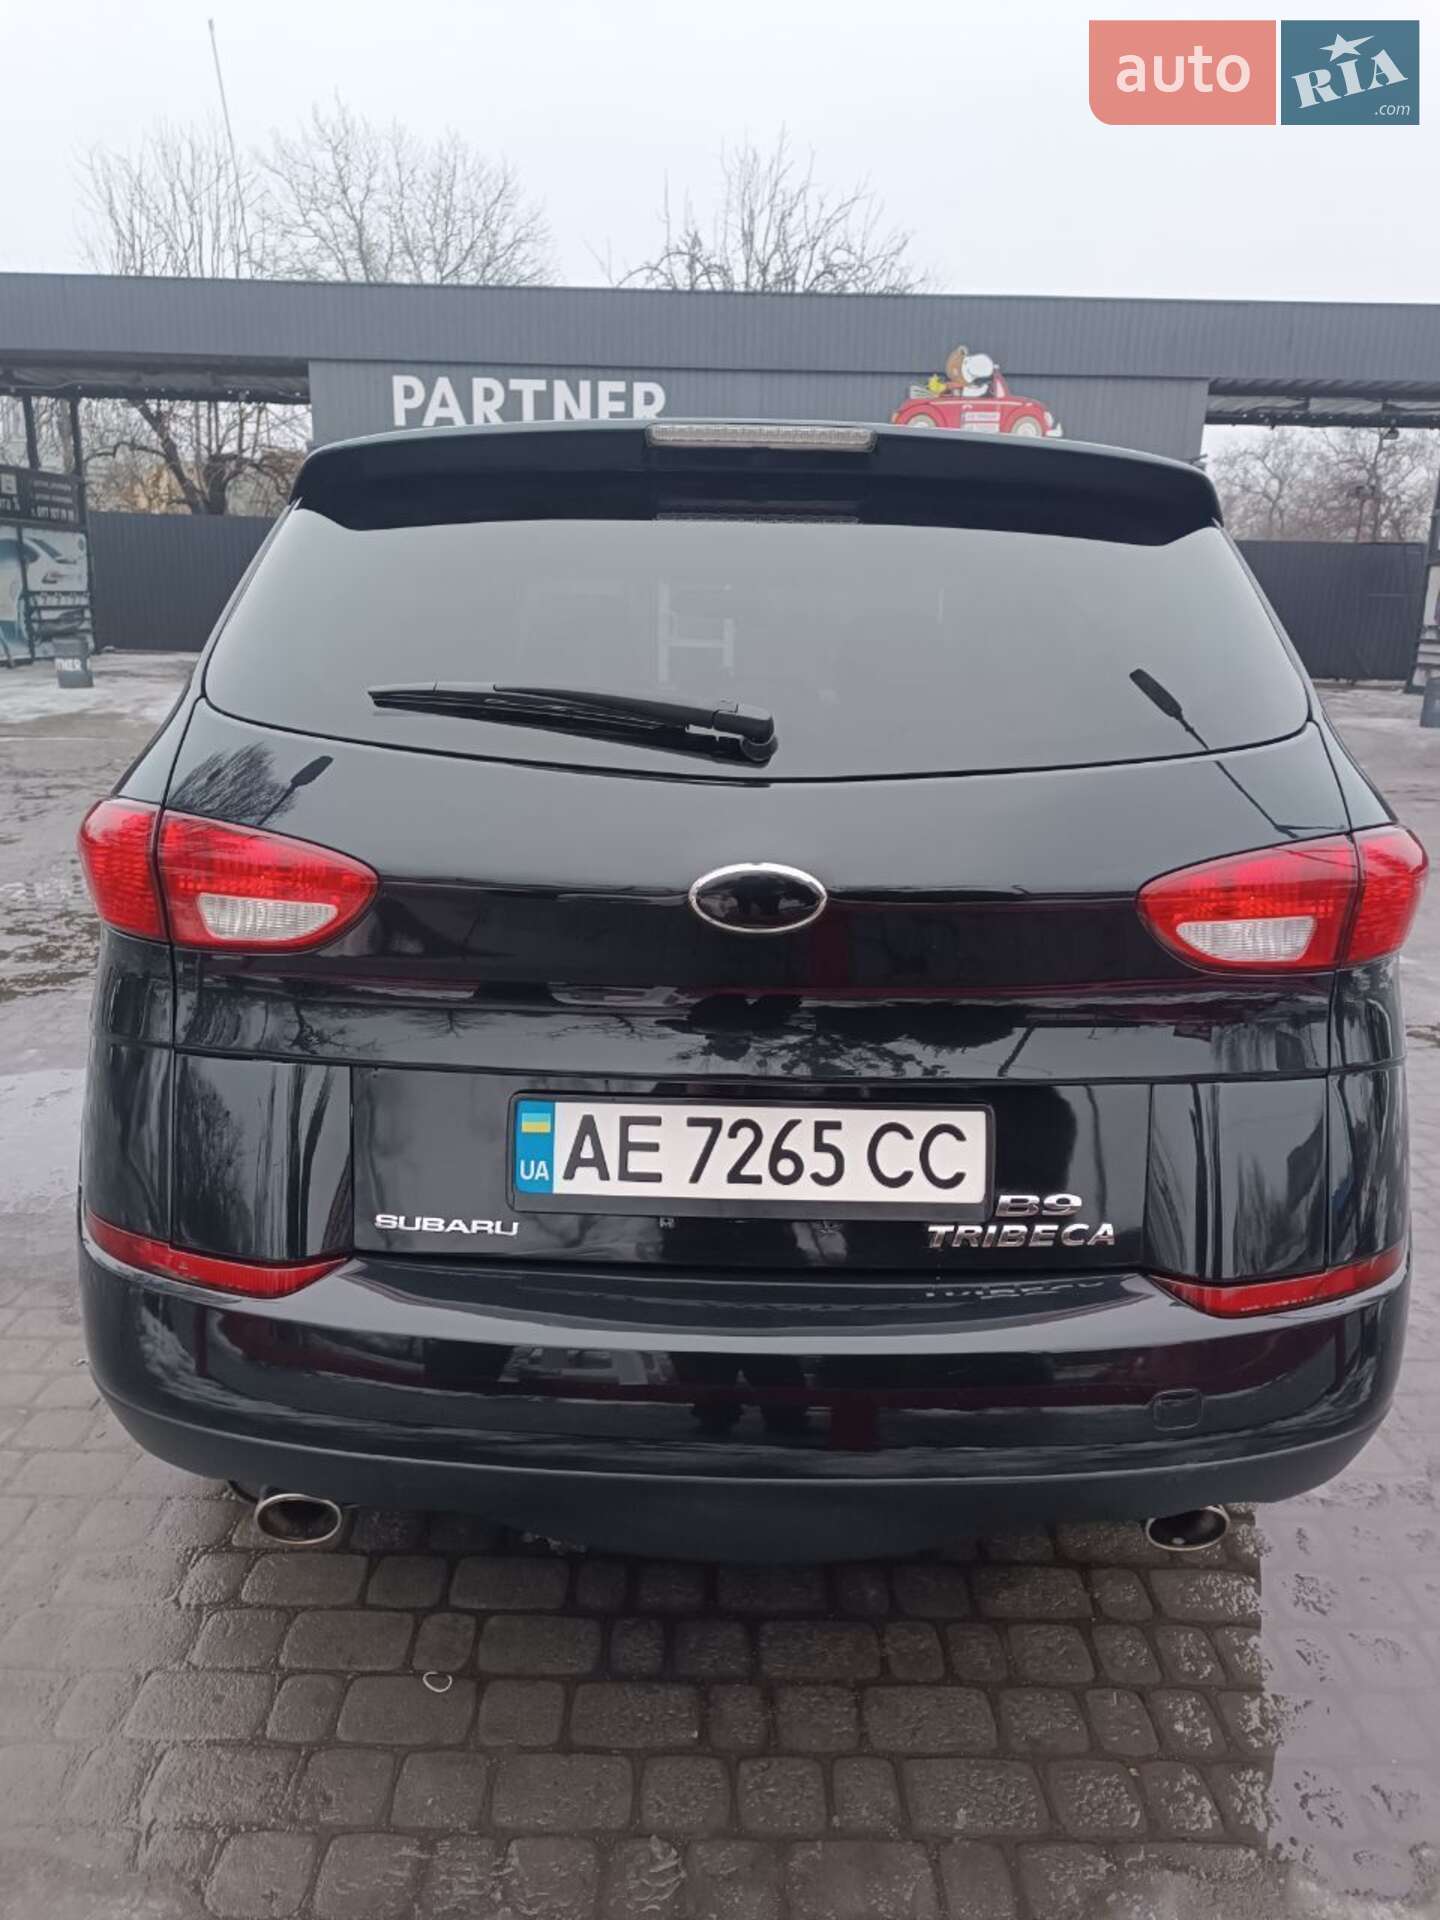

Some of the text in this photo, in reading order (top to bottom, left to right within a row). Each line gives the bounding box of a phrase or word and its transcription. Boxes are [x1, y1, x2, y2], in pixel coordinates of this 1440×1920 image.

[392, 375, 666, 427] PARTNER
[563, 1114, 967, 1189] AE 7265 CC
[520, 1160, 549, 1180] UA
[995, 1193, 1083, 1217] B9
[375, 1213, 519, 1236] SUBARU
[928, 1223, 1116, 1248] TRIBECA
